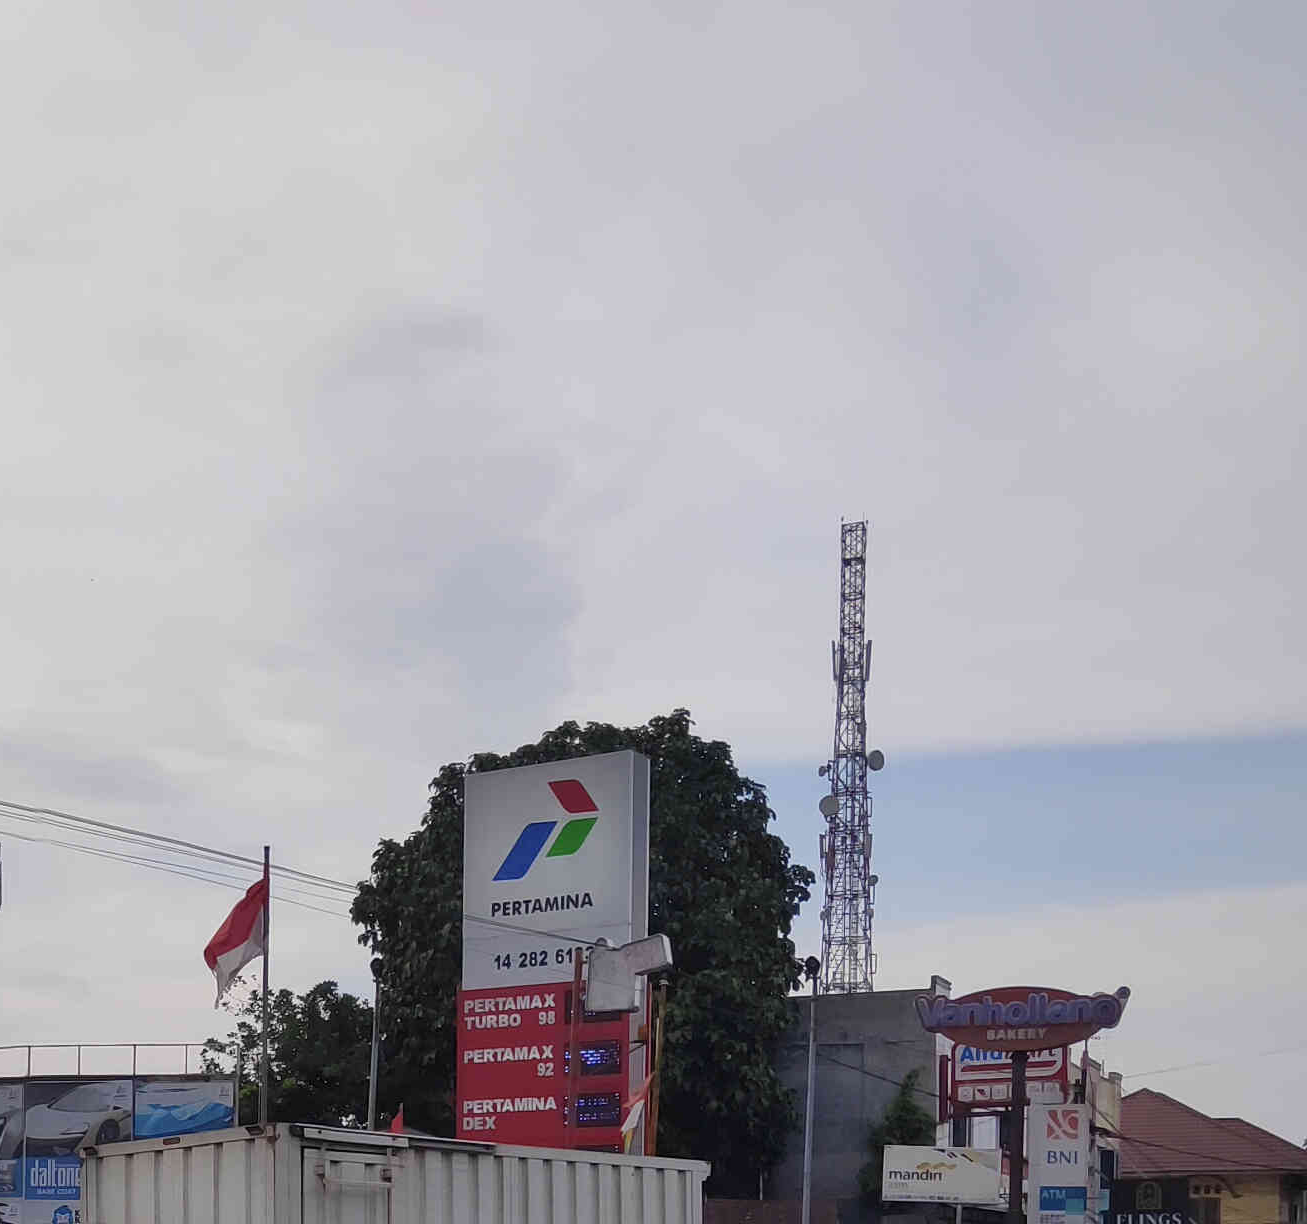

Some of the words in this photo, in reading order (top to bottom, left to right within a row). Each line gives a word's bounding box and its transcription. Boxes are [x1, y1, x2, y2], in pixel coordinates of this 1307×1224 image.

[490, 893, 594, 917] PERTAMINA
[494, 953, 512, 970] 14
[518, 950, 549, 968] 282
[463, 993, 555, 1014] PERTAMAX
[464, 1015, 522, 1029] TURBO
[538, 1011, 556, 1026] 98
[986, 1028, 1046, 1041] BAKERY
[463, 1046, 554, 1064] PERTAMAX
[536, 1063, 555, 1078] 92
[462, 1096, 557, 1115] PERTAMINA
[462, 1115, 496, 1131] DEX
[1046, 1150, 1078, 1165] BNI
[888, 1167, 943, 1182] mandiri
[1041, 1189, 1067, 1200] ATM
